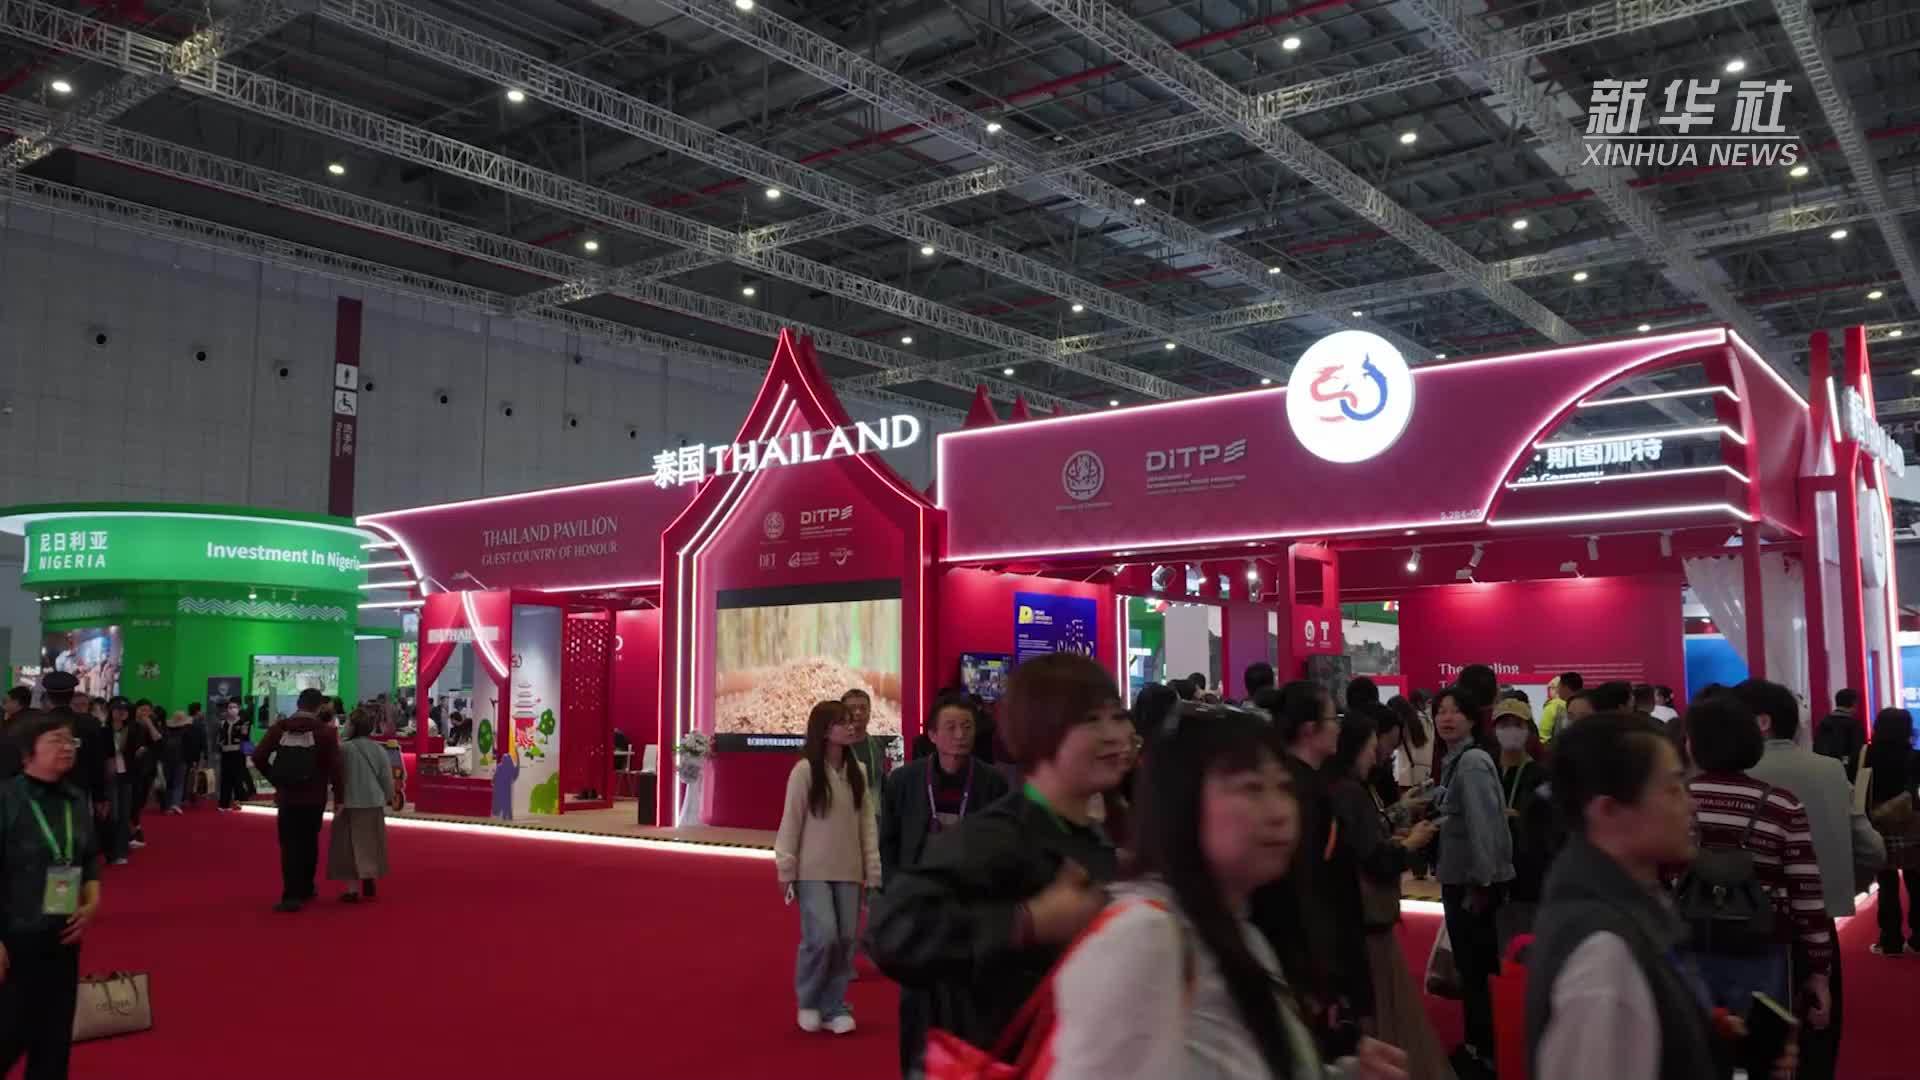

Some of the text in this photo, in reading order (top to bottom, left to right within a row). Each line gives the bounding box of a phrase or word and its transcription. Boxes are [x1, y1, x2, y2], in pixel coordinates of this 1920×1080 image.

[652, 414, 921, 489] 泰国 THAILAND
[40, 531, 108, 551] 尼日利亚
[482, 516, 618, 548] THAILAND PAVILION
[39, 553, 107, 571] NIGERIA
[206, 541, 309, 565] Investment
[311, 552, 326, 567] In
[482, 541, 618, 566] GUEST COUNTRY OF HONOUR
